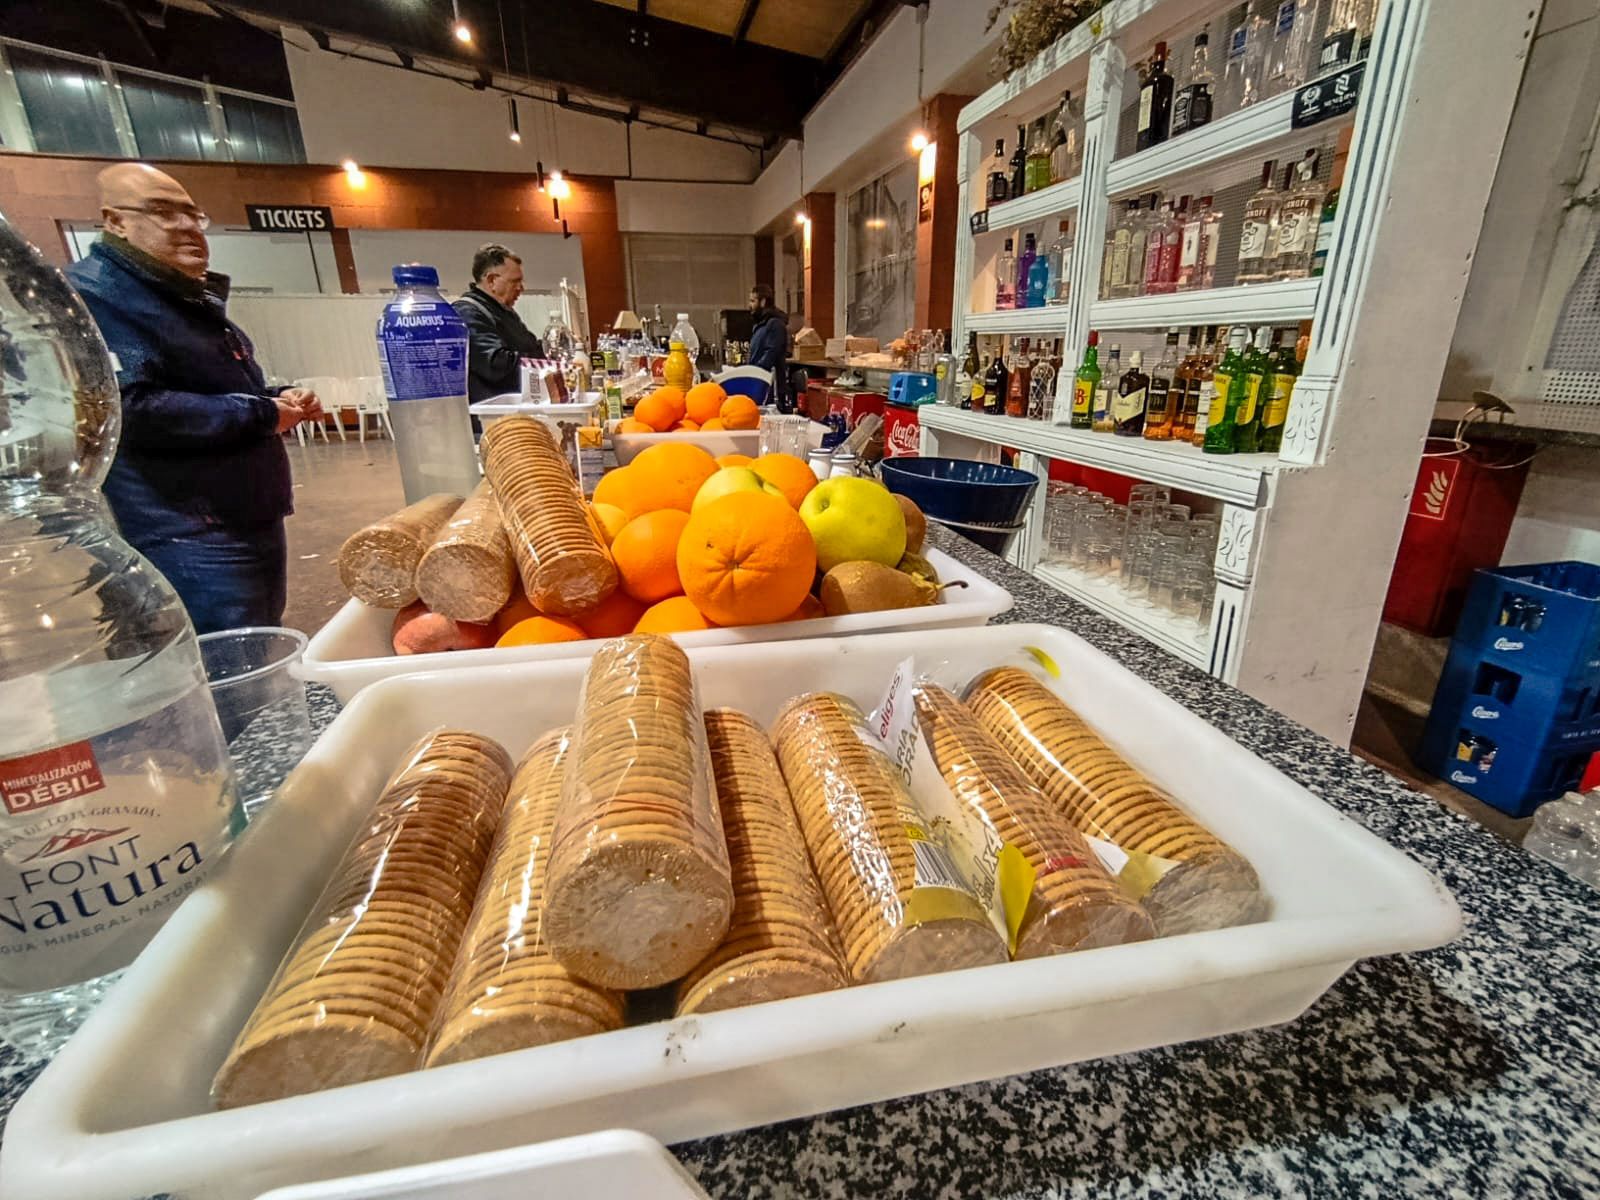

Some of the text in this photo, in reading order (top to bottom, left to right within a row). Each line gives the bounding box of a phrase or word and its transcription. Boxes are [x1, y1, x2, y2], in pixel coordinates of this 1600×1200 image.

[255, 208, 326, 229] TICKETS
[394, 315, 445, 328] AQUARIUS
[880, 671, 901, 739] eliges
[2, 760, 92, 791] MINERALIZACIÓN
[8, 774, 100, 809] DÉBIL
[19, 834, 141, 894] FONT
[0, 841, 204, 933] Natura
[44, 914, 132, 946] MINERAL
